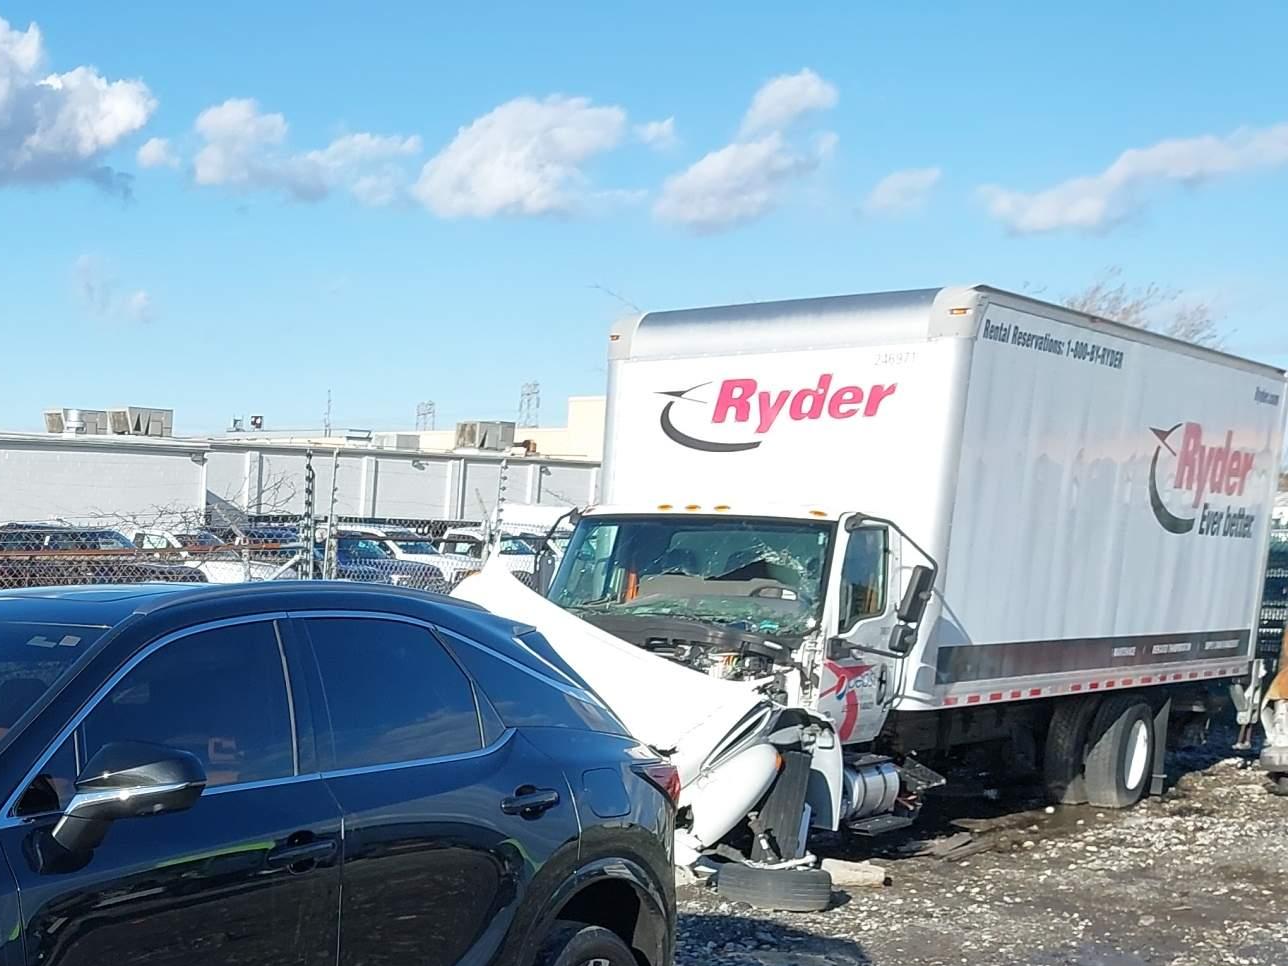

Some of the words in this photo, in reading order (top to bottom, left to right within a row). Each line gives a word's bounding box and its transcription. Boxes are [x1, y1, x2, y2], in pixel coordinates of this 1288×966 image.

[983, 319, 1012, 343] Rental
[1012, 325, 1065, 355] Reservations:
[711, 373, 898, 433] Ryder
[1173, 421, 1255, 509] Ryder
[1198, 503, 1224, 536] Ever
